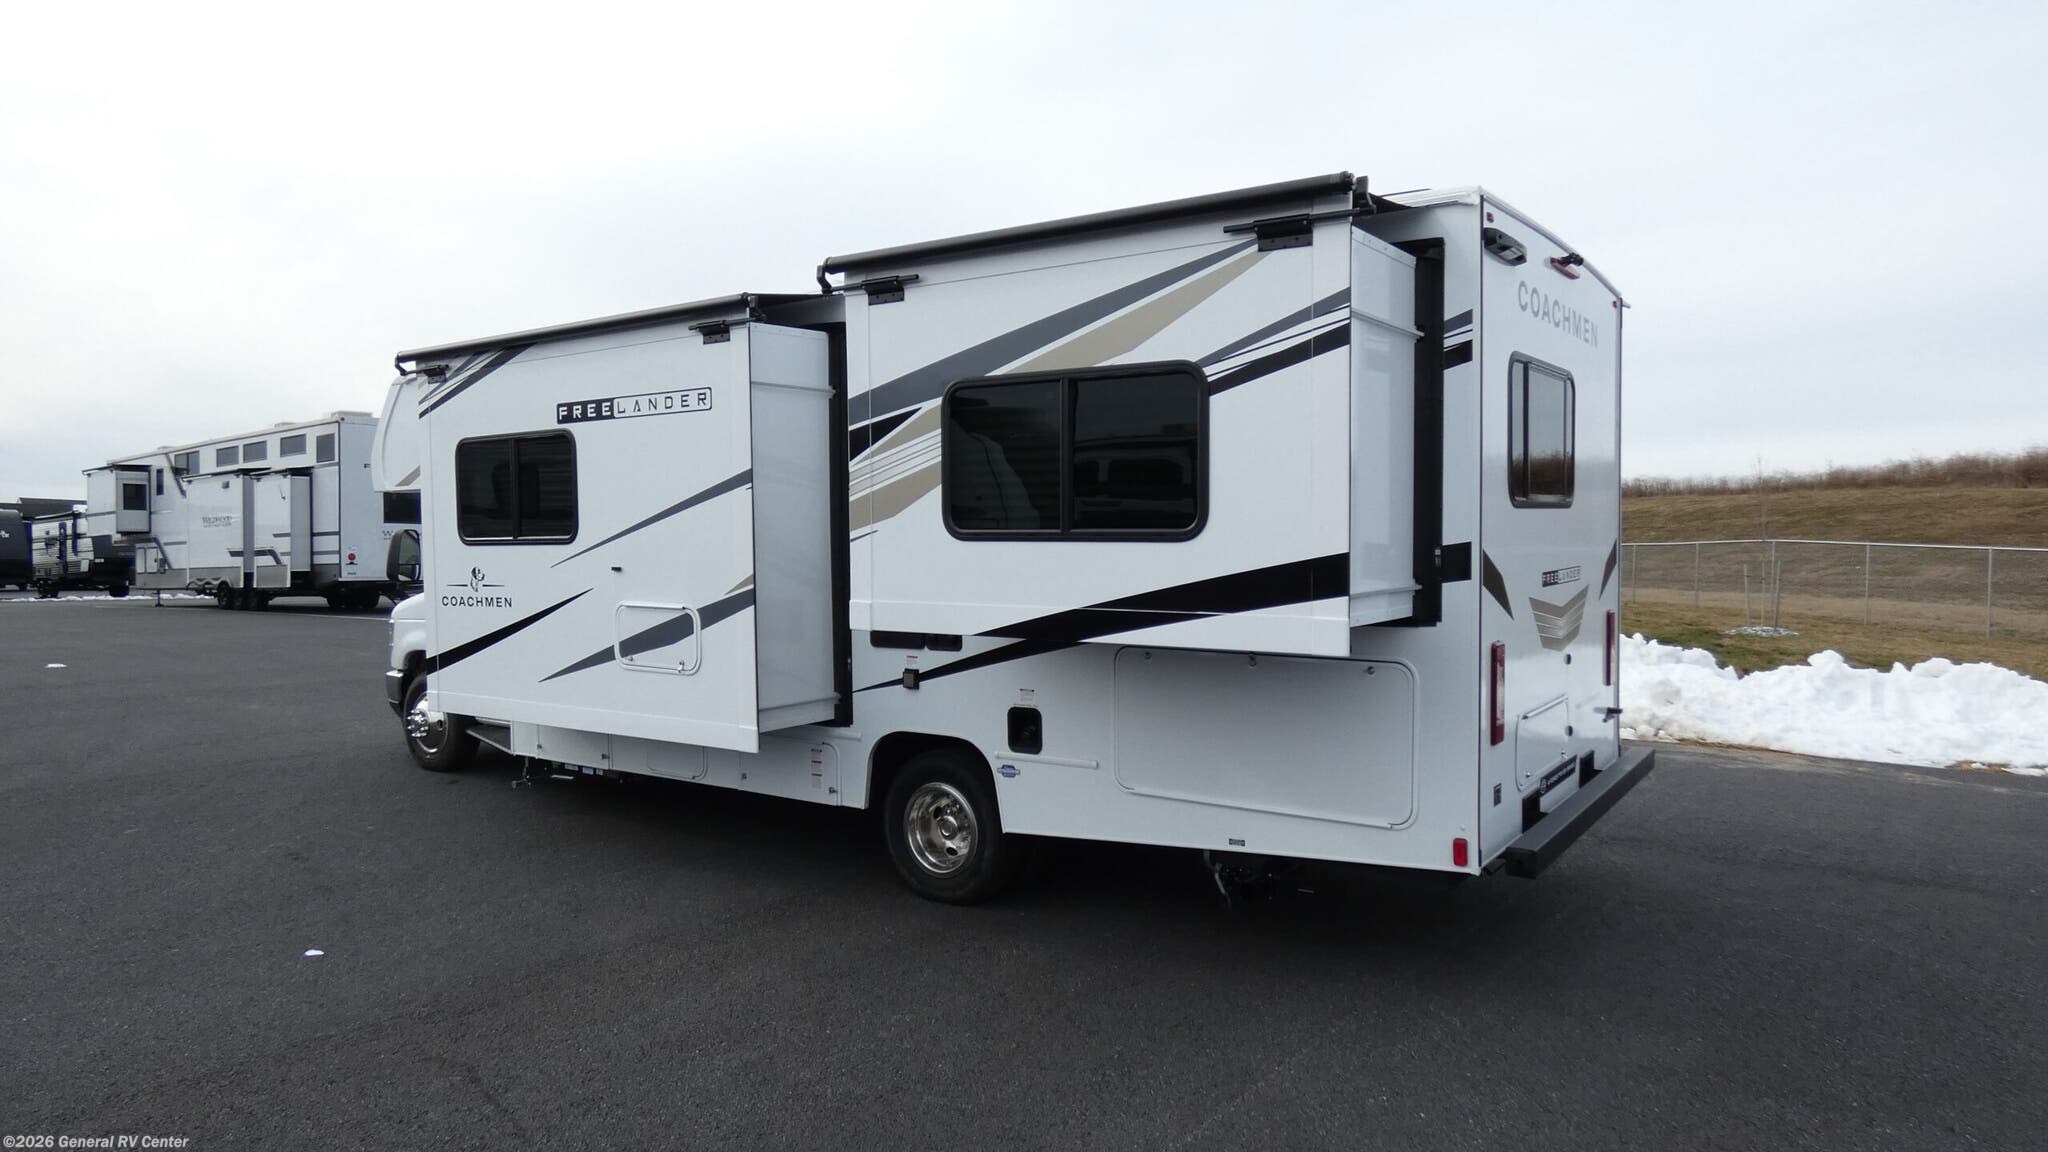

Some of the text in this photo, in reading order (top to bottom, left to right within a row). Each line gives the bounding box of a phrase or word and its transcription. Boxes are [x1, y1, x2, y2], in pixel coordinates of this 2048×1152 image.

[1517, 280, 1599, 348] COACHMEN
[558, 391, 708, 421] FREELANDER
[441, 594, 513, 608] COACHMEN
